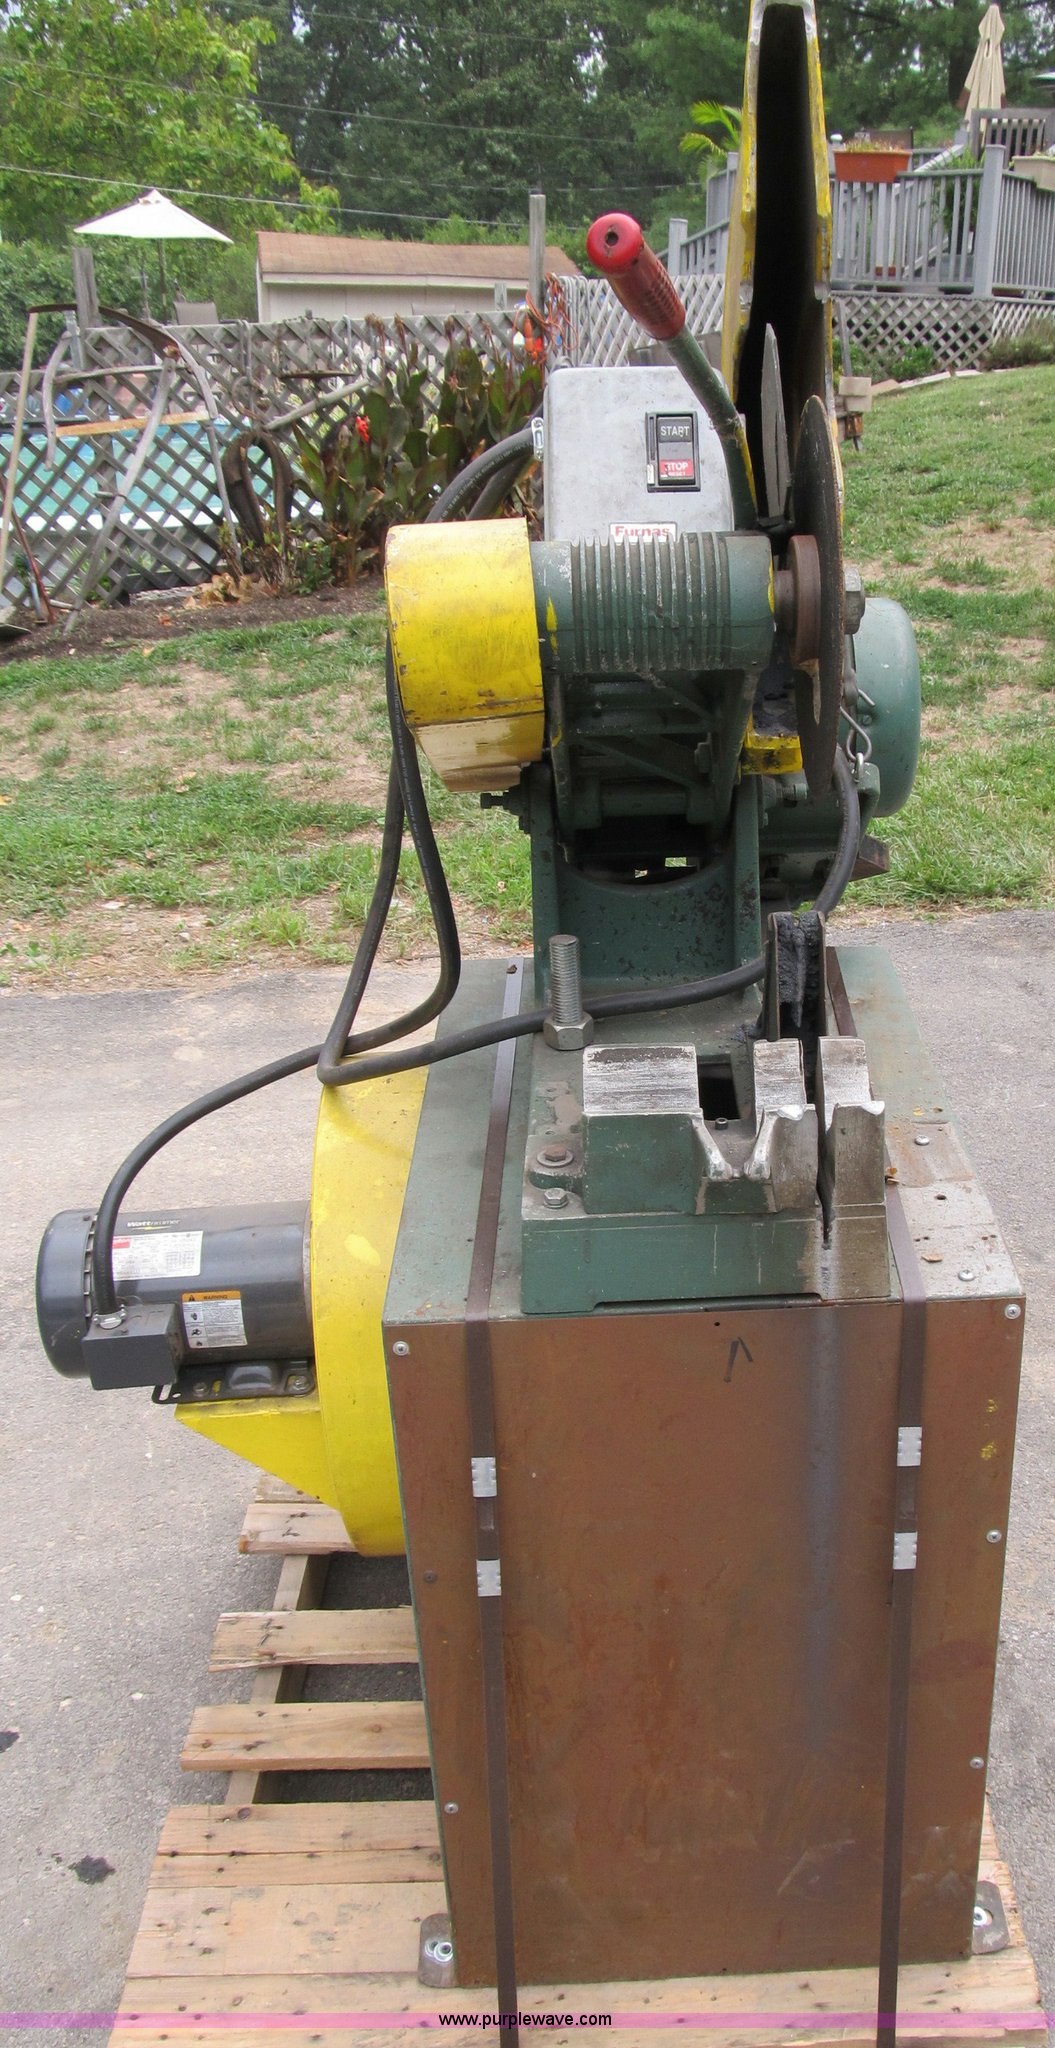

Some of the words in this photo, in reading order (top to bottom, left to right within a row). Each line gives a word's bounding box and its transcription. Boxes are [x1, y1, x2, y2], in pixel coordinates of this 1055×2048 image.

[660, 425, 690, 437] START
[665, 462, 689, 472] STOP
[615, 525, 670, 537] Furnas
